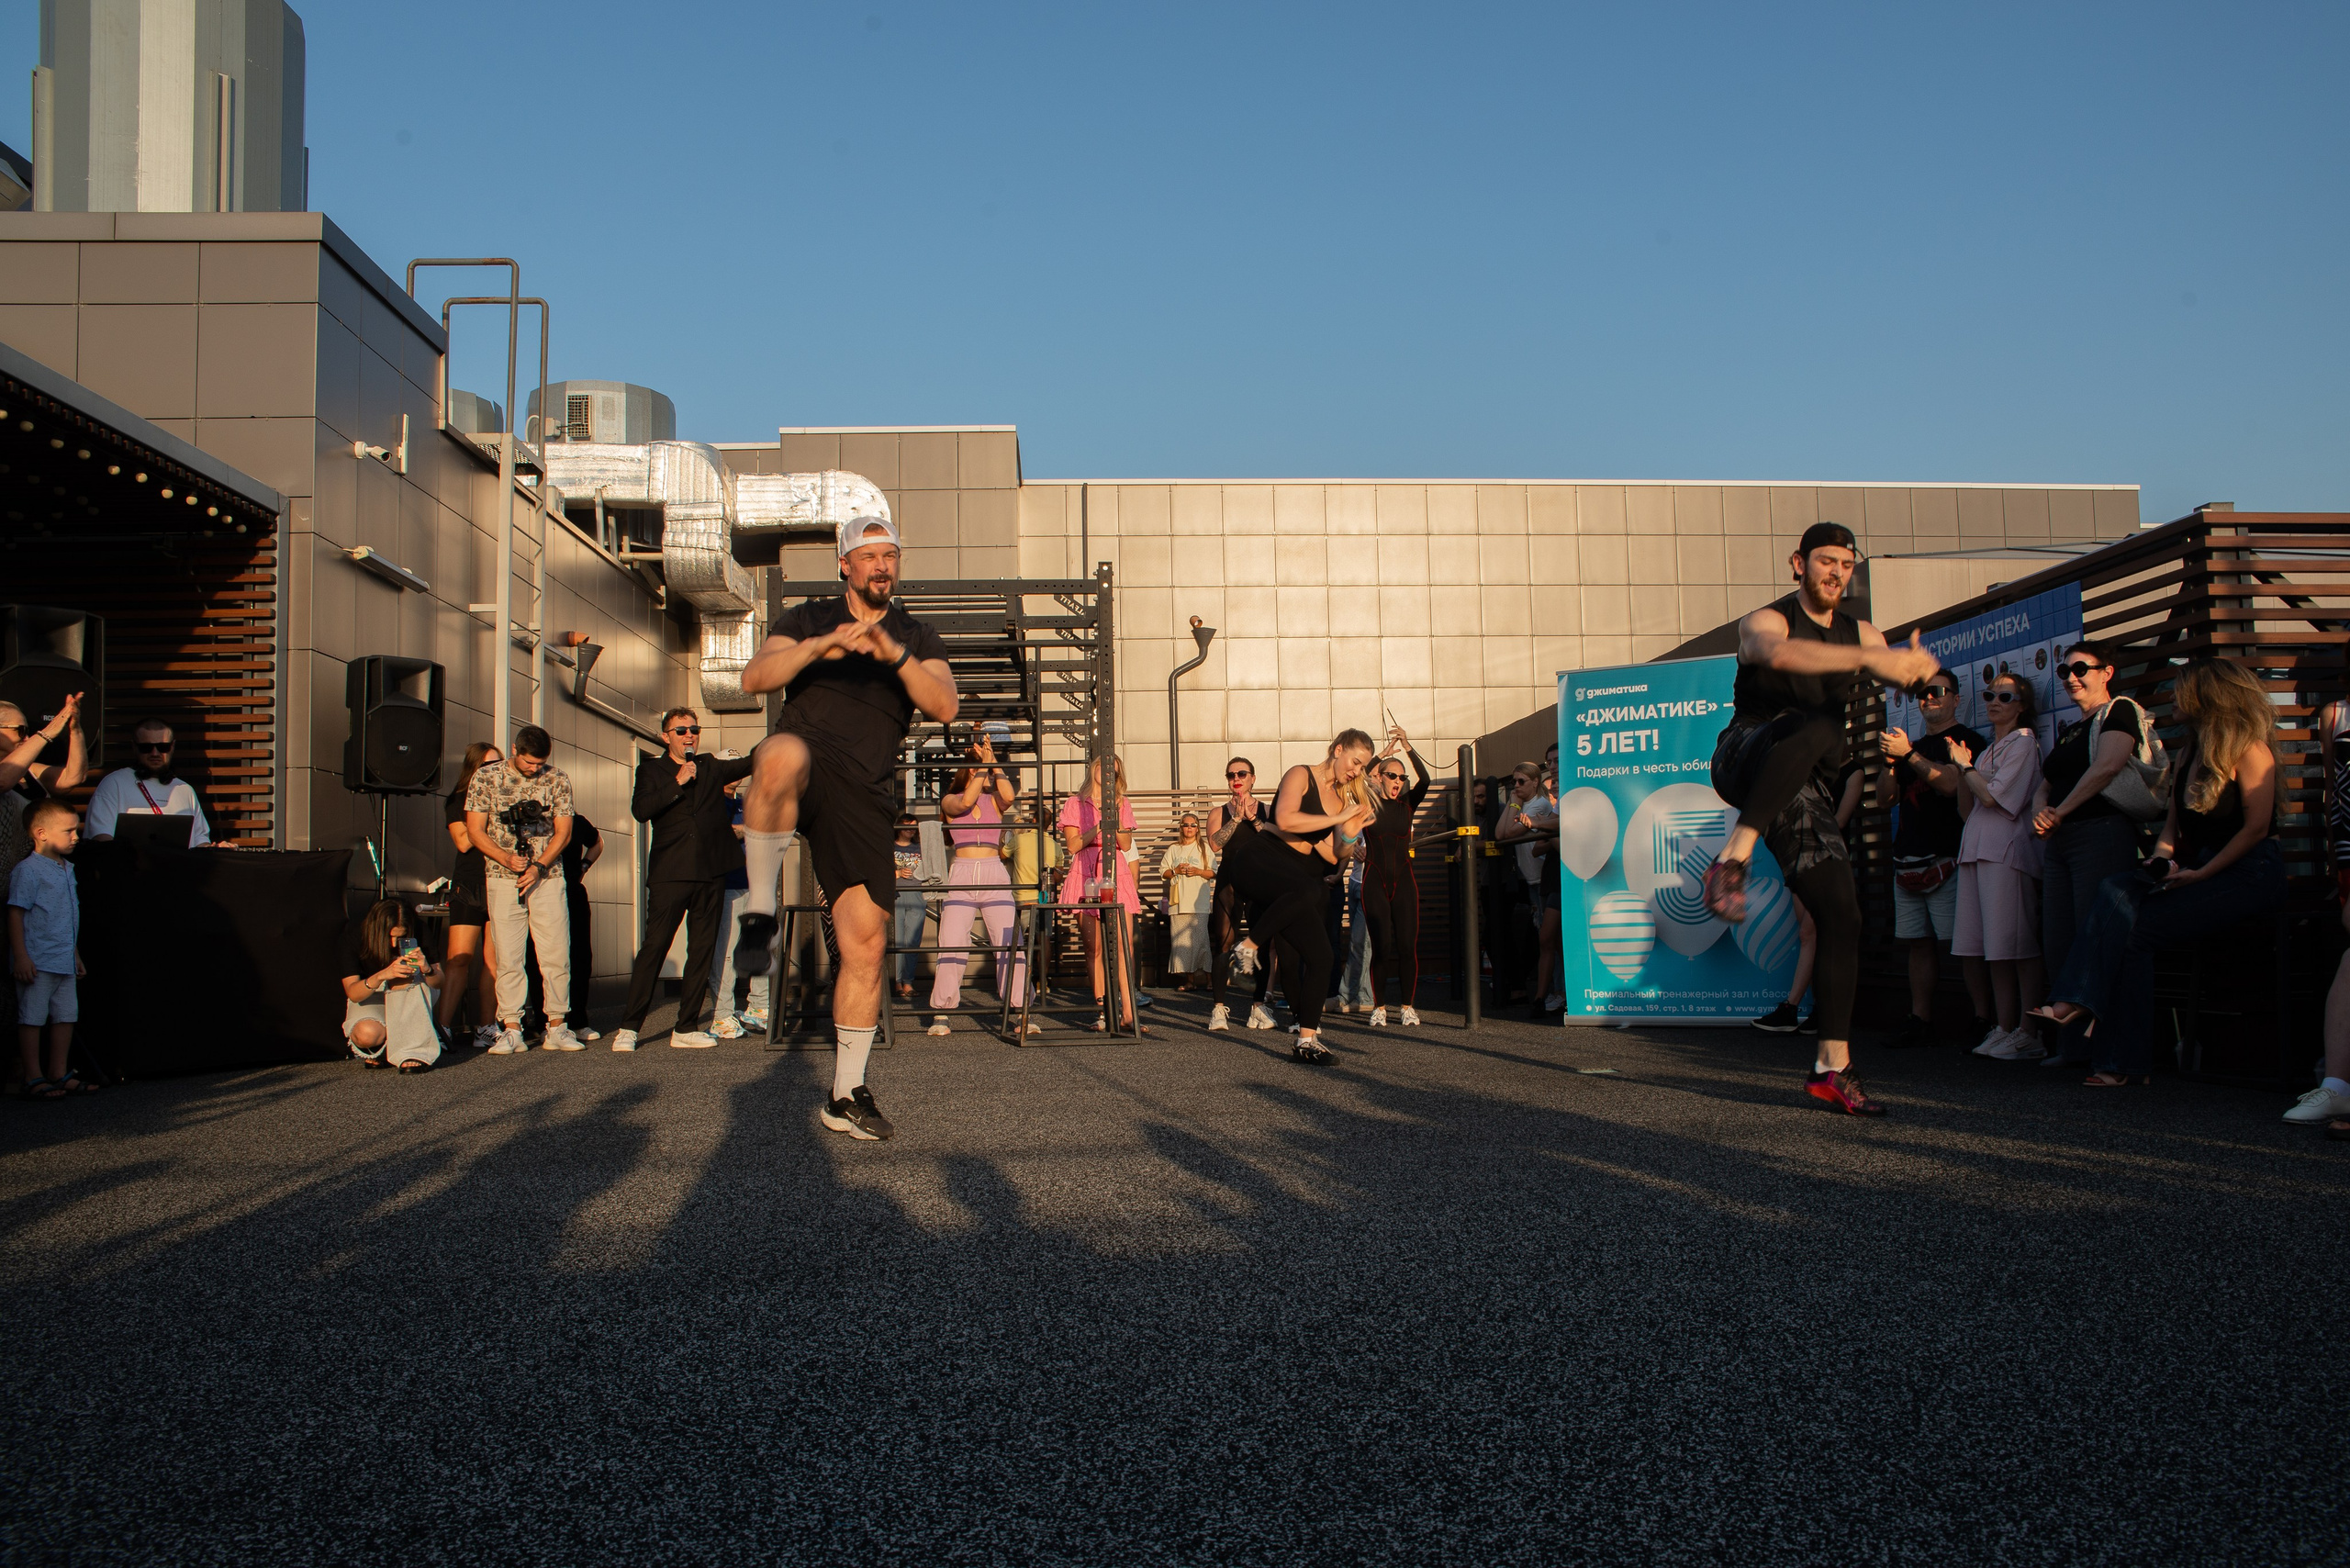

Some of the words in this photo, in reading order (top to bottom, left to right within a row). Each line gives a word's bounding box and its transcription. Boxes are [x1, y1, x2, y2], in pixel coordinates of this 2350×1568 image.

[1977, 611, 2031, 645] УСПЕХА
[1575, 699, 1718, 727] «ДЖИМАТИКЕ»
[1576, 734, 1592, 756] 5
[1598, 728, 1660, 756] ЛЕТ!
[1577, 766, 1629, 778] Подарки
[1632, 765, 1639, 774] в
[1643, 763, 1679, 774] честь
[1583, 989, 1655, 1000] Премиальный
[1658, 989, 1729, 1000] тренажерный
[1731, 991, 1750, 999] зал
[1751, 991, 1760, 999] и
[1607, 1004, 1644, 1013] Садовая,
[1646, 1004, 1662, 1013] 159,
[1681, 1004, 1687, 1013] 1,
